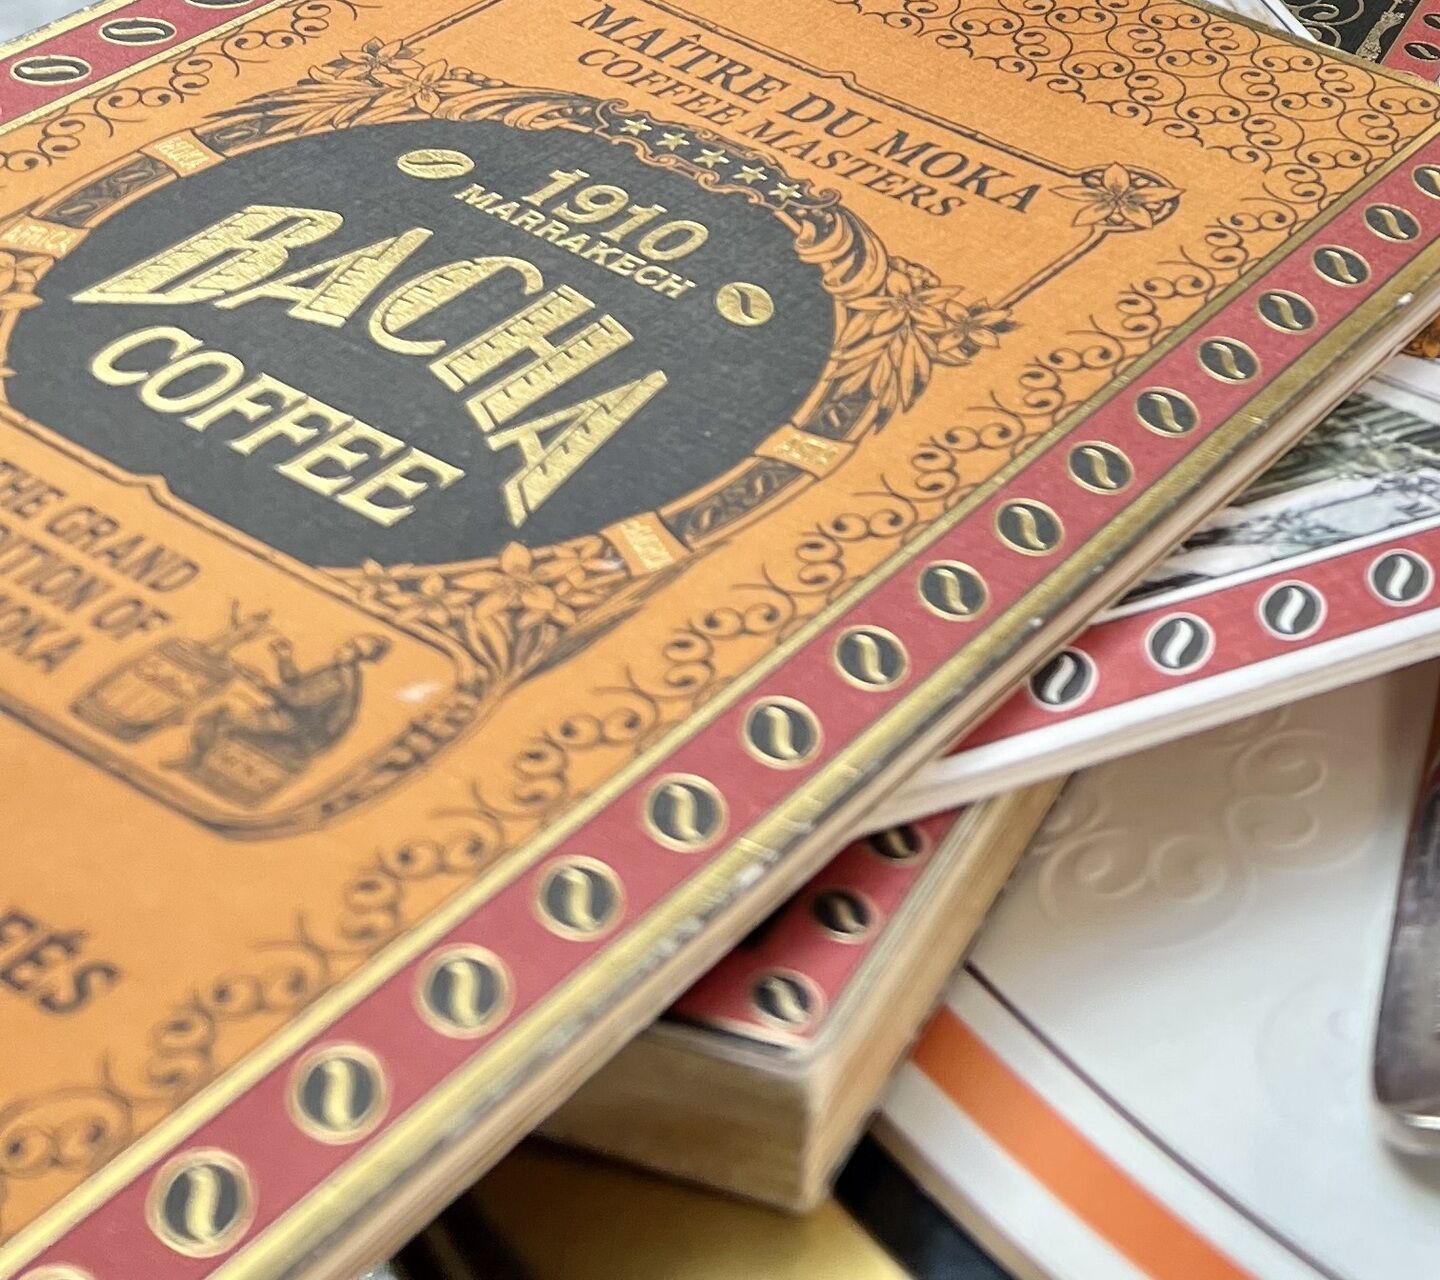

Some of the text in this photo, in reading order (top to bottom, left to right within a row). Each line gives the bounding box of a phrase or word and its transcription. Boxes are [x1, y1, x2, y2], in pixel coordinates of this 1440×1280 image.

[572, 3, 1042, 215] MAÎTRE DU MOKA
[577, 49, 969, 219] COFFEE MASTERS
[454, 183, 698, 299] MARRAKECH
[521, 168, 709, 264] 1910
[72, 204, 670, 529] BACHA
[91, 326, 467, 527] COFFEE
[46, 506, 200, 592] GRAND
[90, 597, 173, 640] OF
